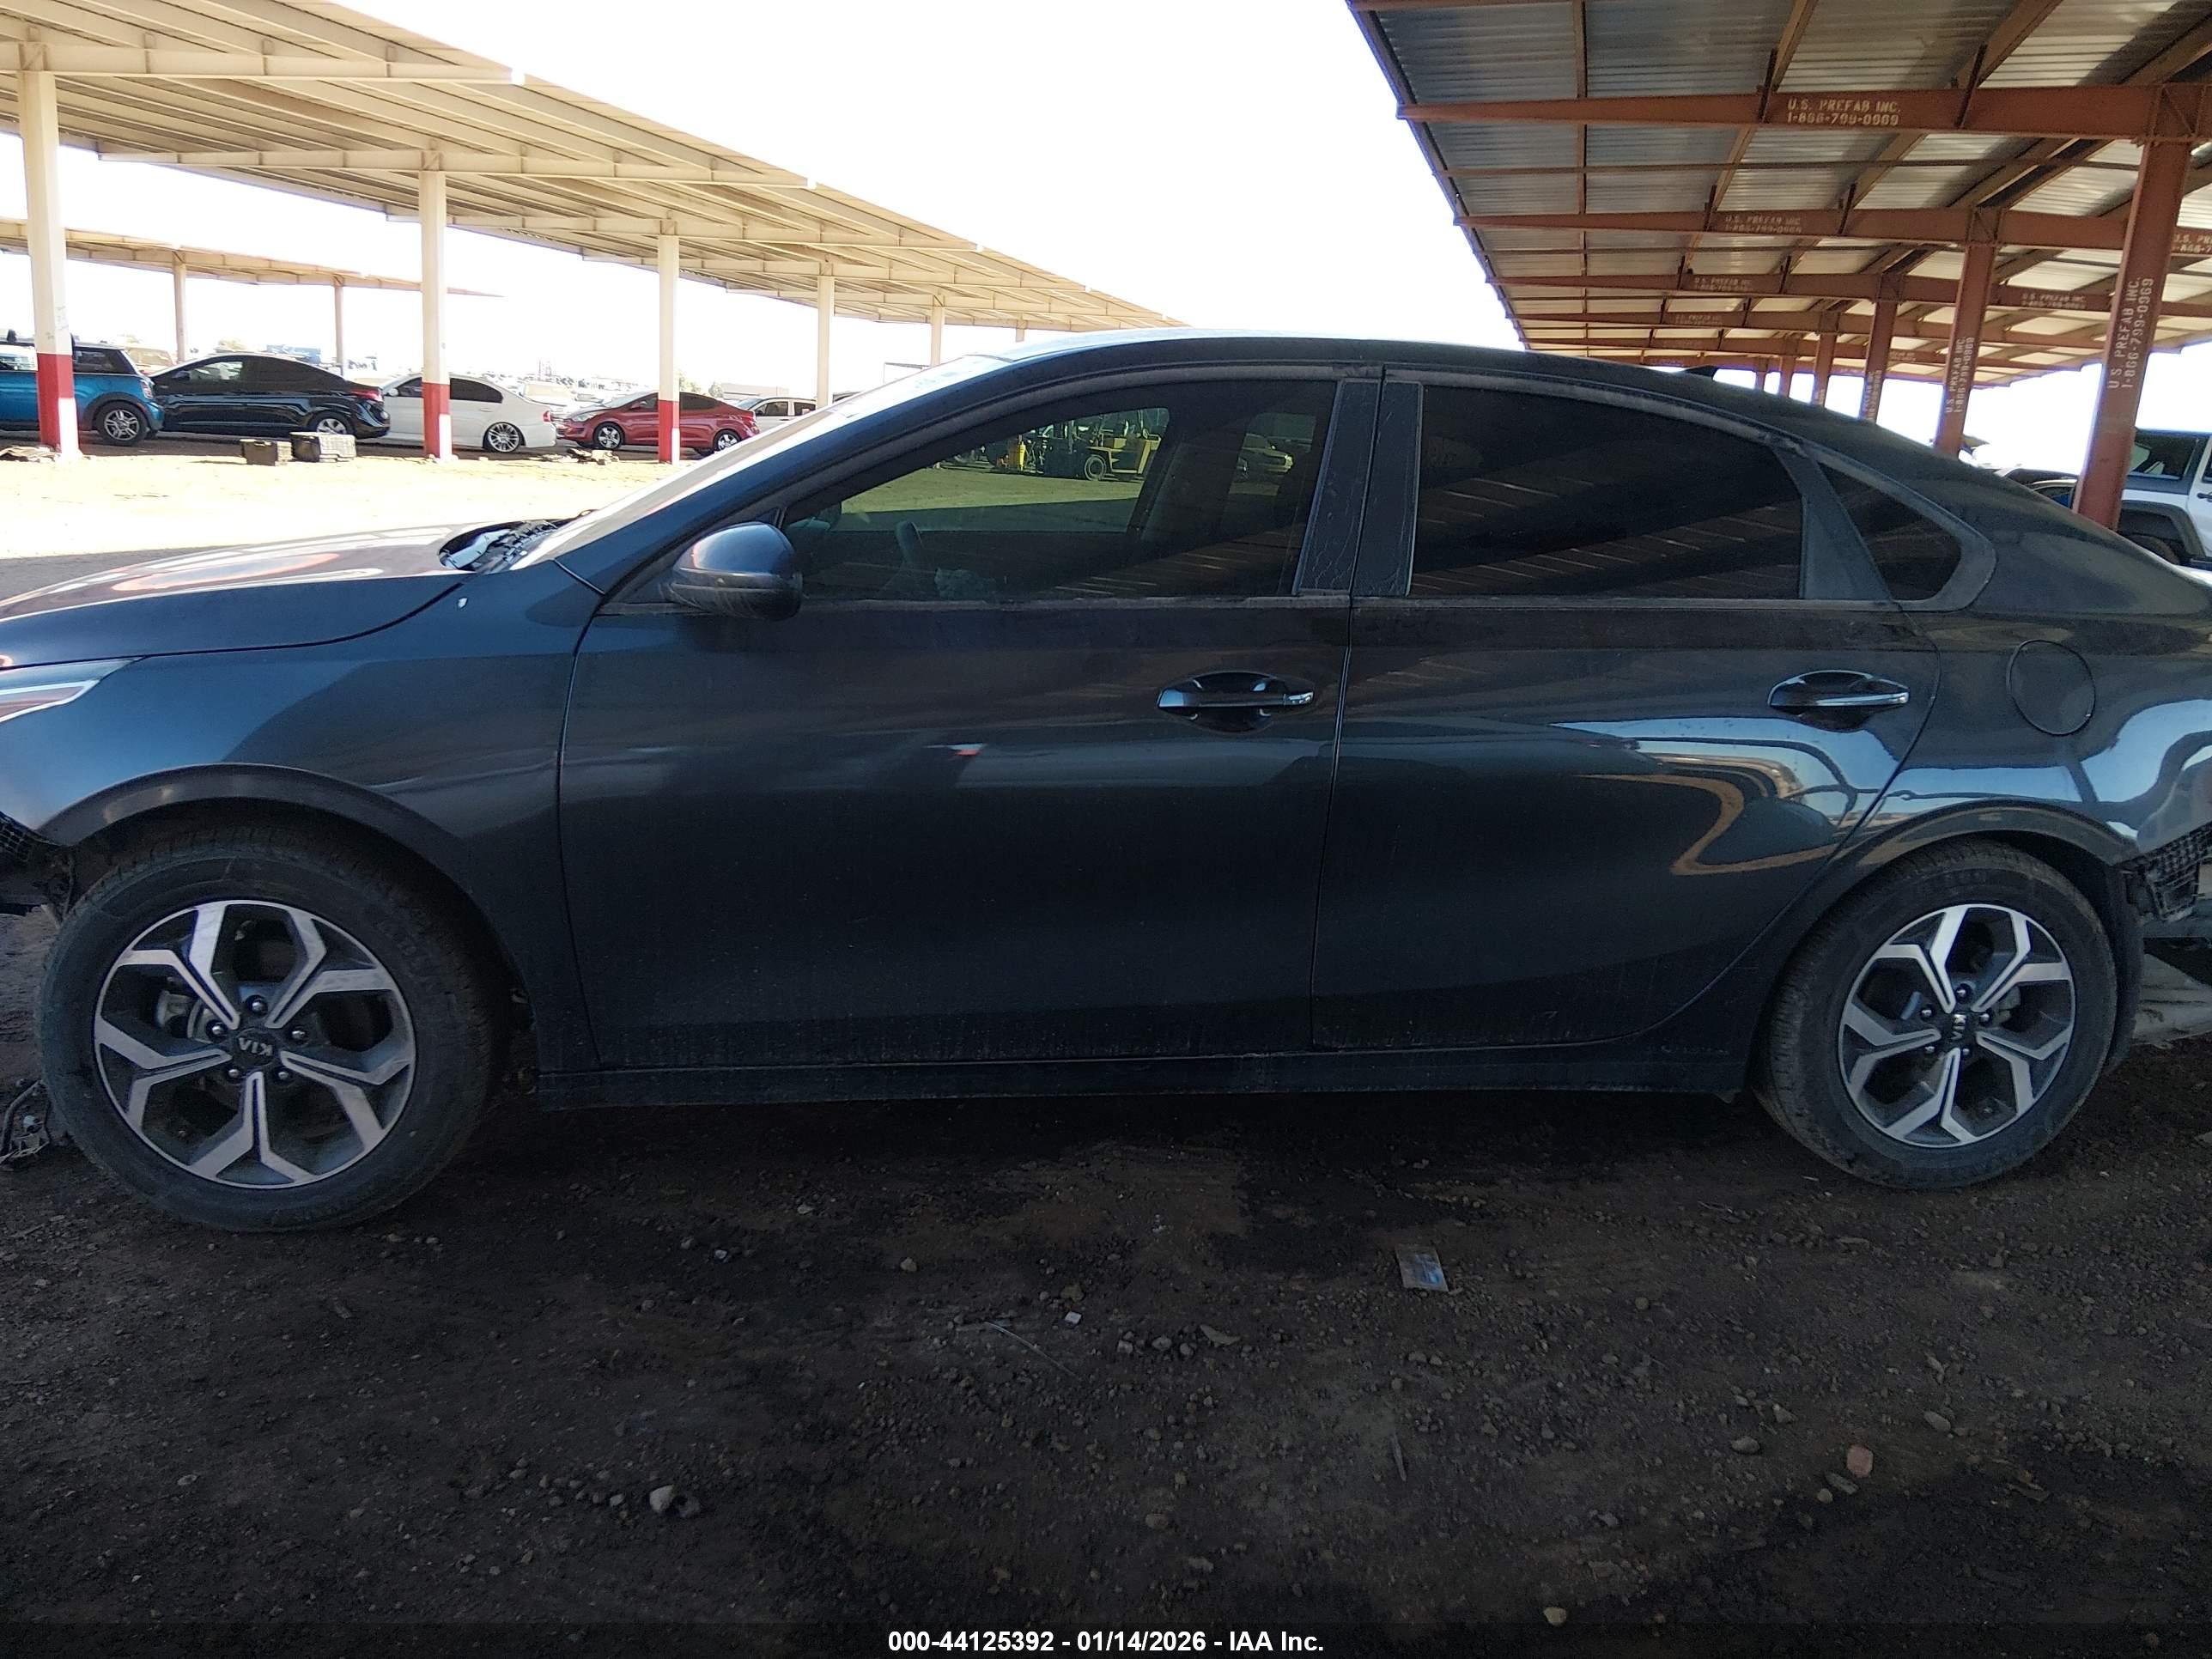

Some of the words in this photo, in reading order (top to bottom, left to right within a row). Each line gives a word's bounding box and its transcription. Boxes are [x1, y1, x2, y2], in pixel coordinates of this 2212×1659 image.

[1787, 98, 1813, 111] U.S.
[1820, 99, 1870, 112] PREFAB
[1875, 100, 1902, 112] INC.
[2114, 307, 2135, 358] PREFAB
[2125, 276, 2142, 301] INC.
[2121, 277, 2154, 388] 1-866-799-0969
[239, 1037, 273, 1056] KIA
